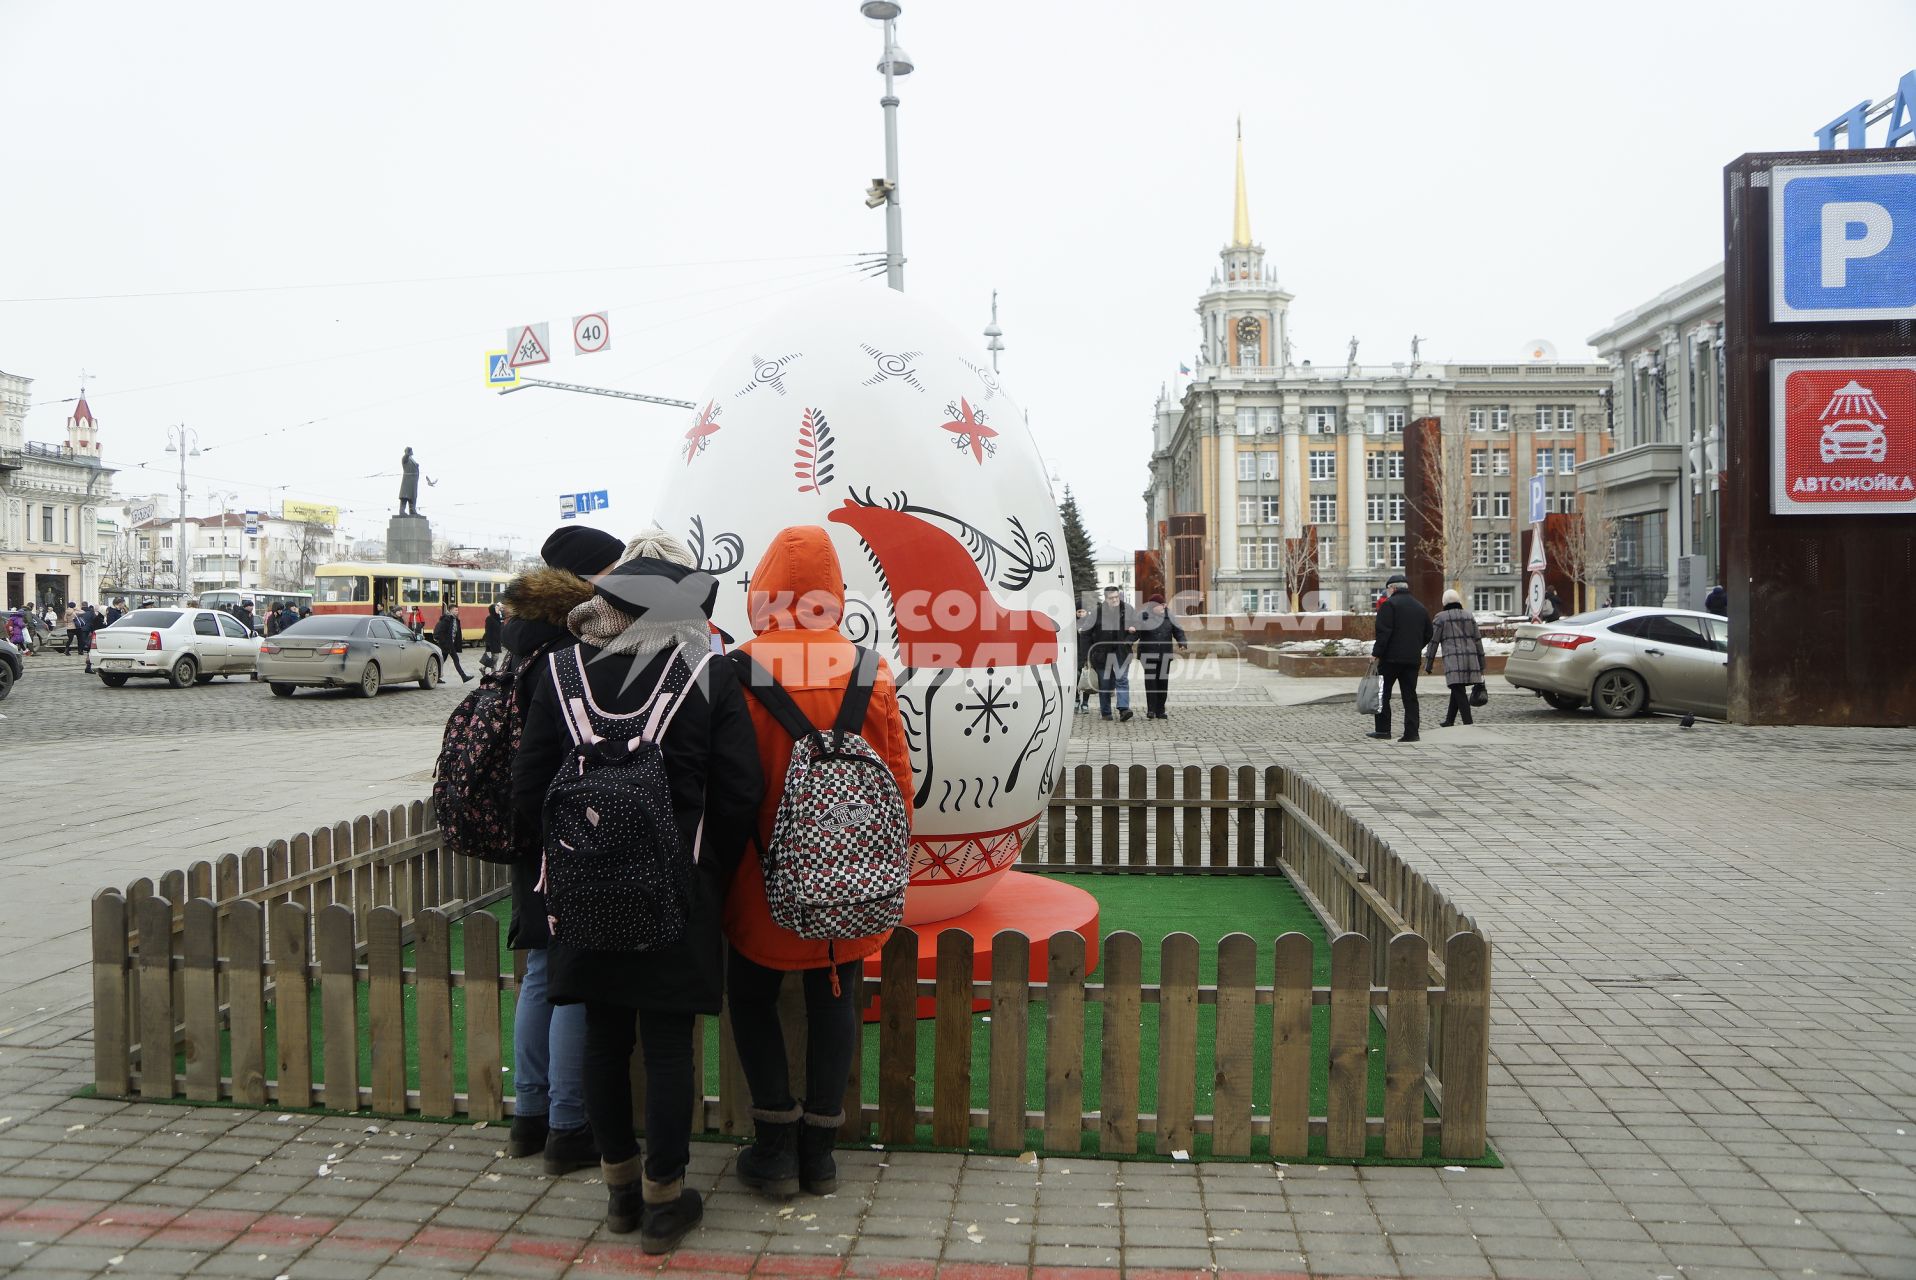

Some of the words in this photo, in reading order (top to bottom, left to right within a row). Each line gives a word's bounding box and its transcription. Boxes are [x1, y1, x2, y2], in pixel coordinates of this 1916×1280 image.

[1821, 202, 1894, 288] P
[582, 325, 601, 341] 40
[1792, 473, 1914, 492] АВТОМОЙКА
[1533, 482, 1542, 517] P
[1534, 585, 1539, 602] 5
[830, 806, 849, 818] VANS
[835, 812, 851, 823] THE
